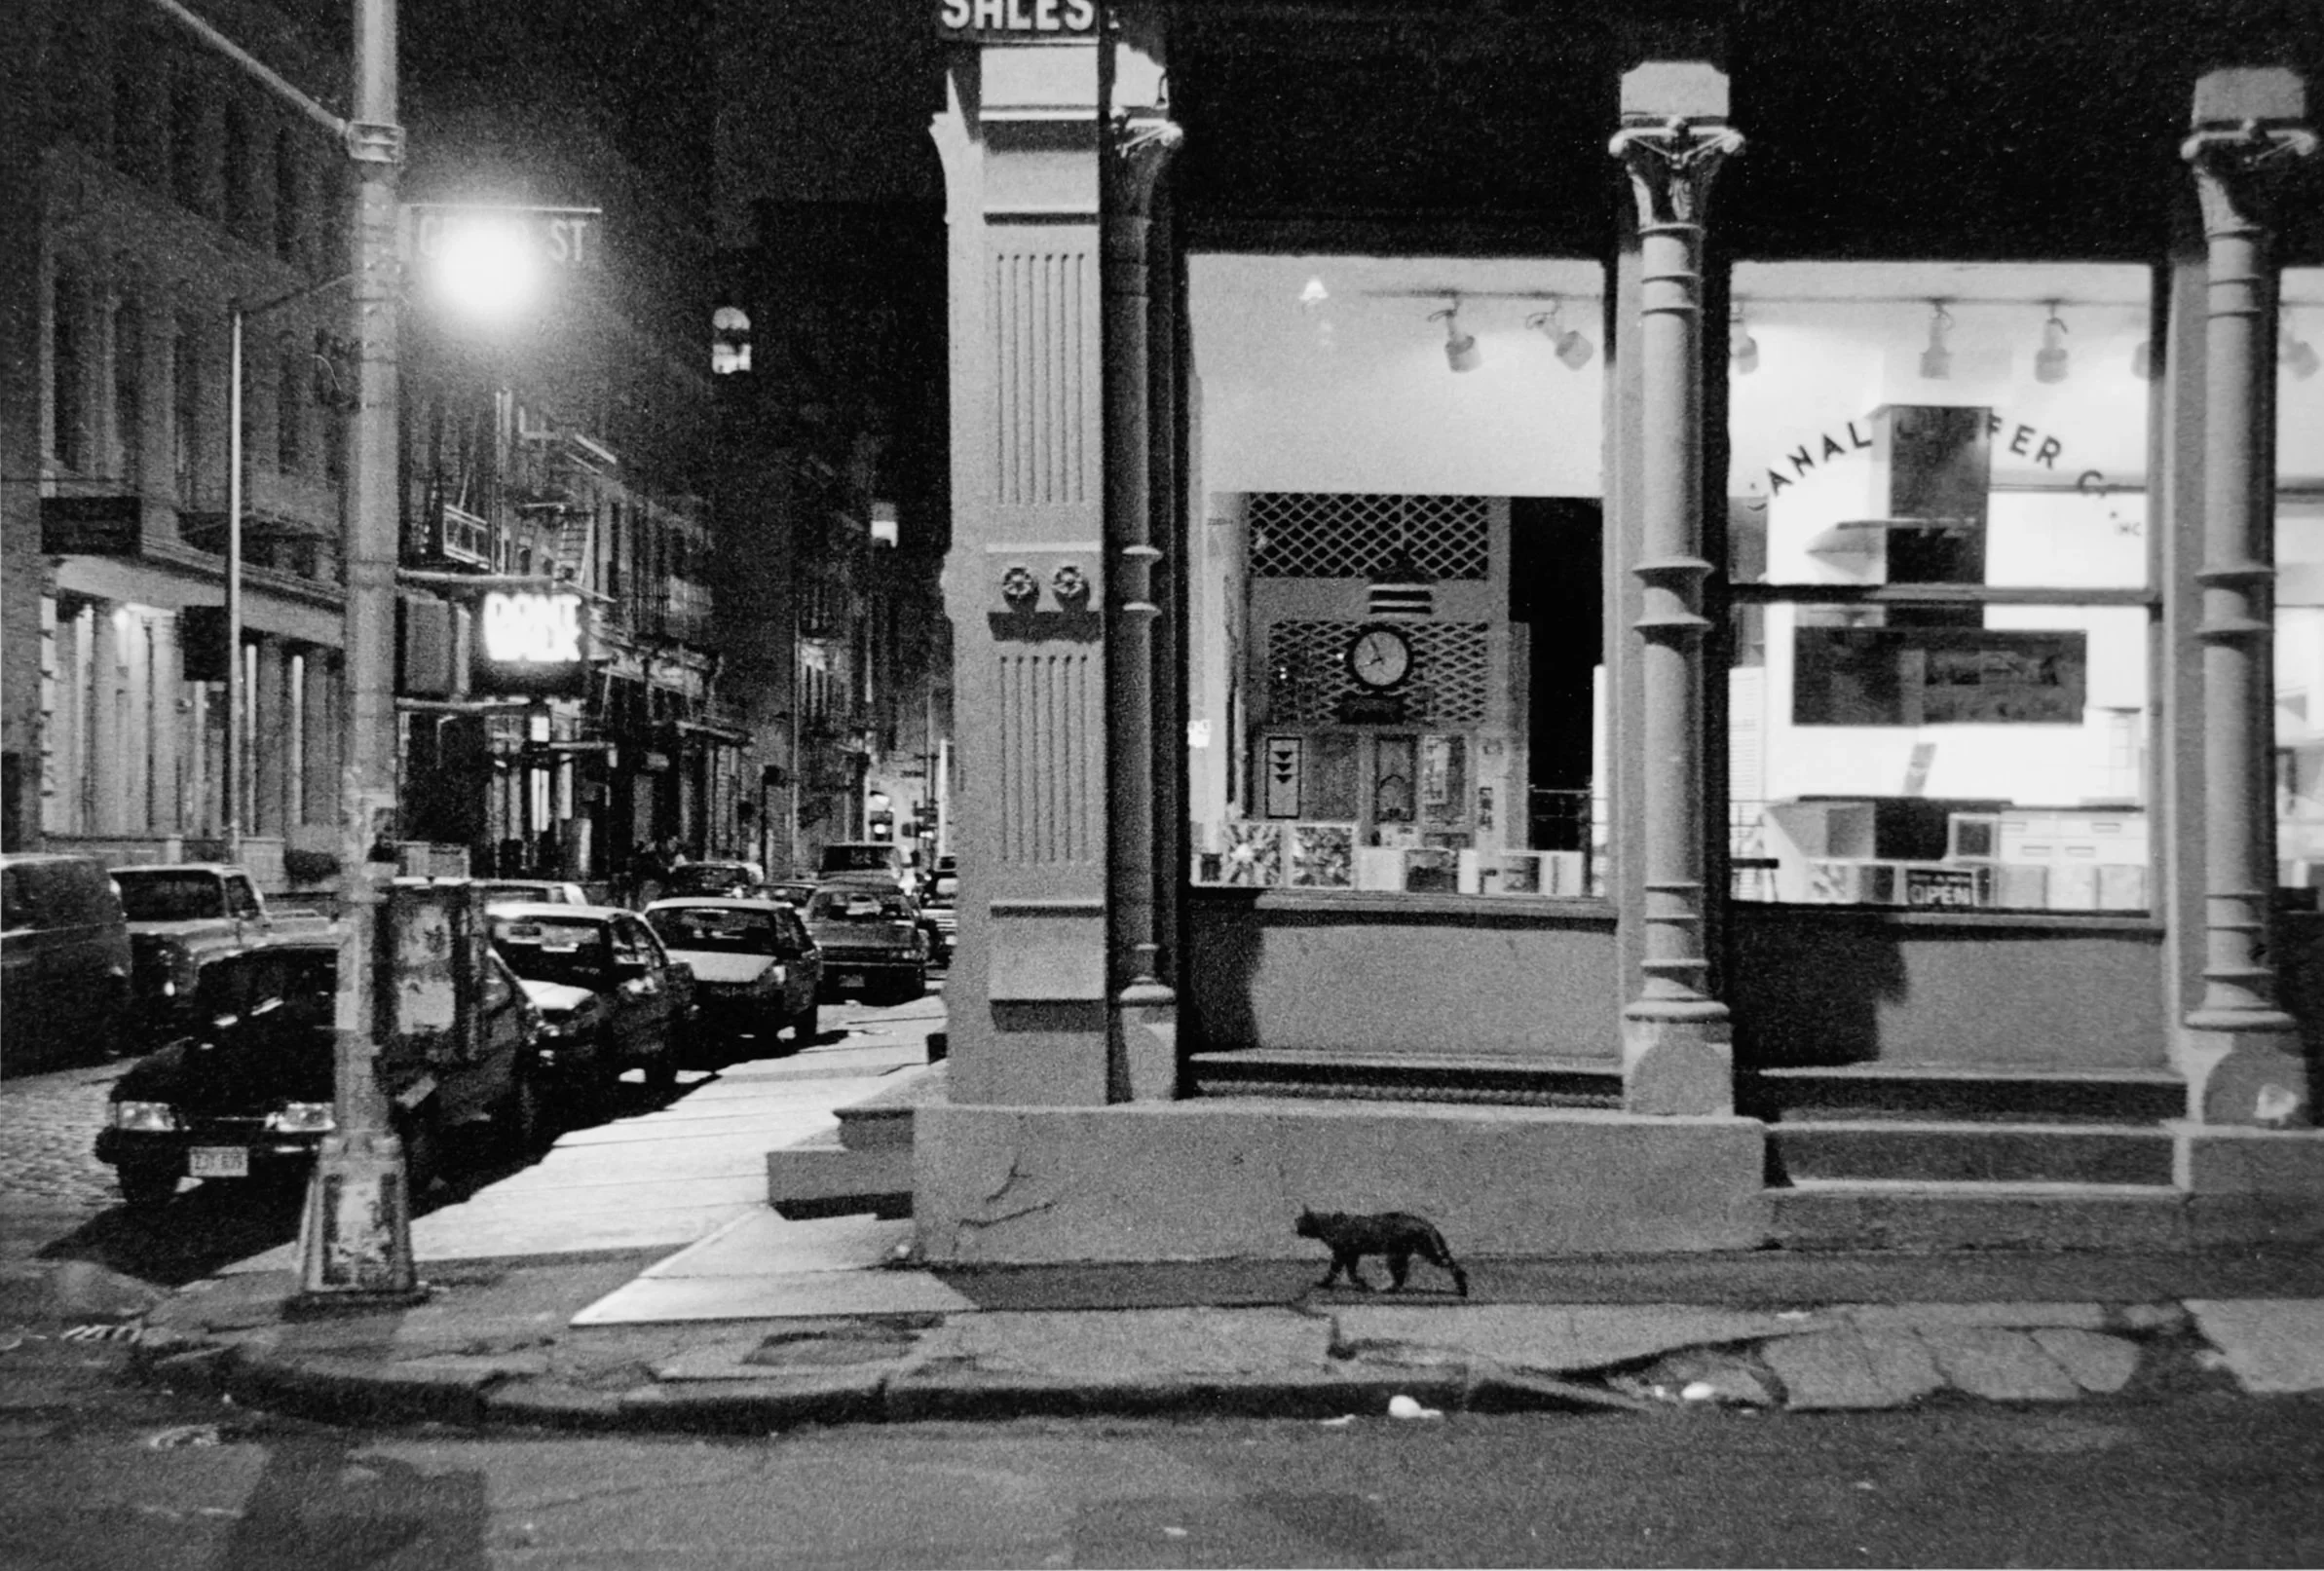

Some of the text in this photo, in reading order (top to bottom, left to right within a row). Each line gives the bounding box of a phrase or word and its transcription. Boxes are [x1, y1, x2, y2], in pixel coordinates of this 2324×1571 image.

[941, 0, 1095, 30] SALES
[547, 219, 588, 263] ST
[1908, 883, 1972, 907] OPEN
